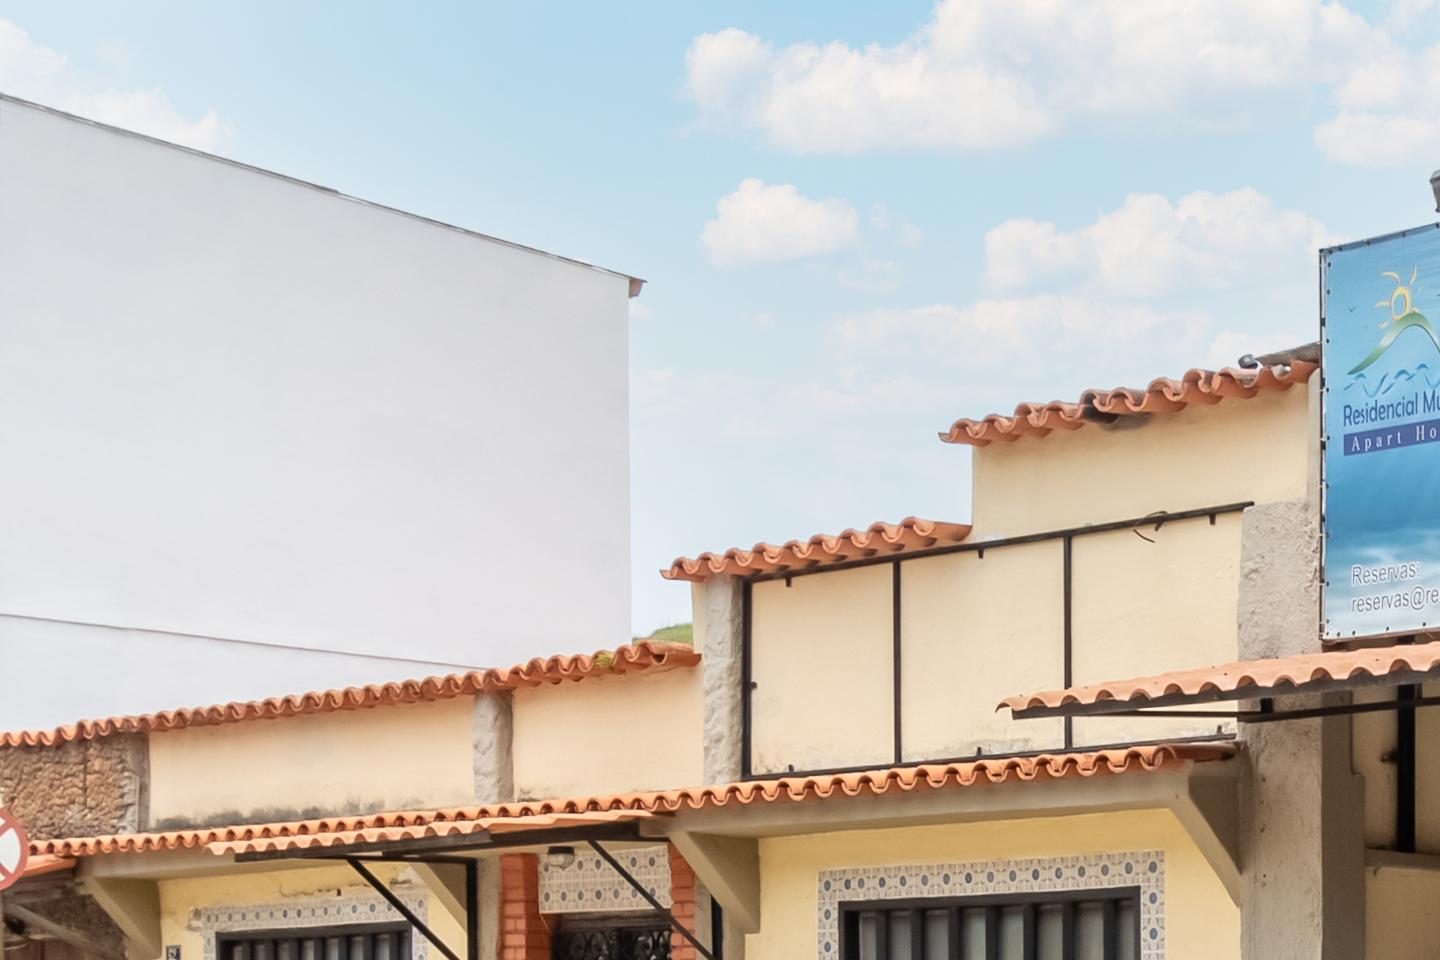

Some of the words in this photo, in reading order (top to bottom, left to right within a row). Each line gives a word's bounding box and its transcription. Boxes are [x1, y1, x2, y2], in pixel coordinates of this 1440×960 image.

[1343, 392, 1418, 427] Residencial
[1352, 432, 1402, 452] Apart
[1352, 561, 1420, 586] Reservas:
